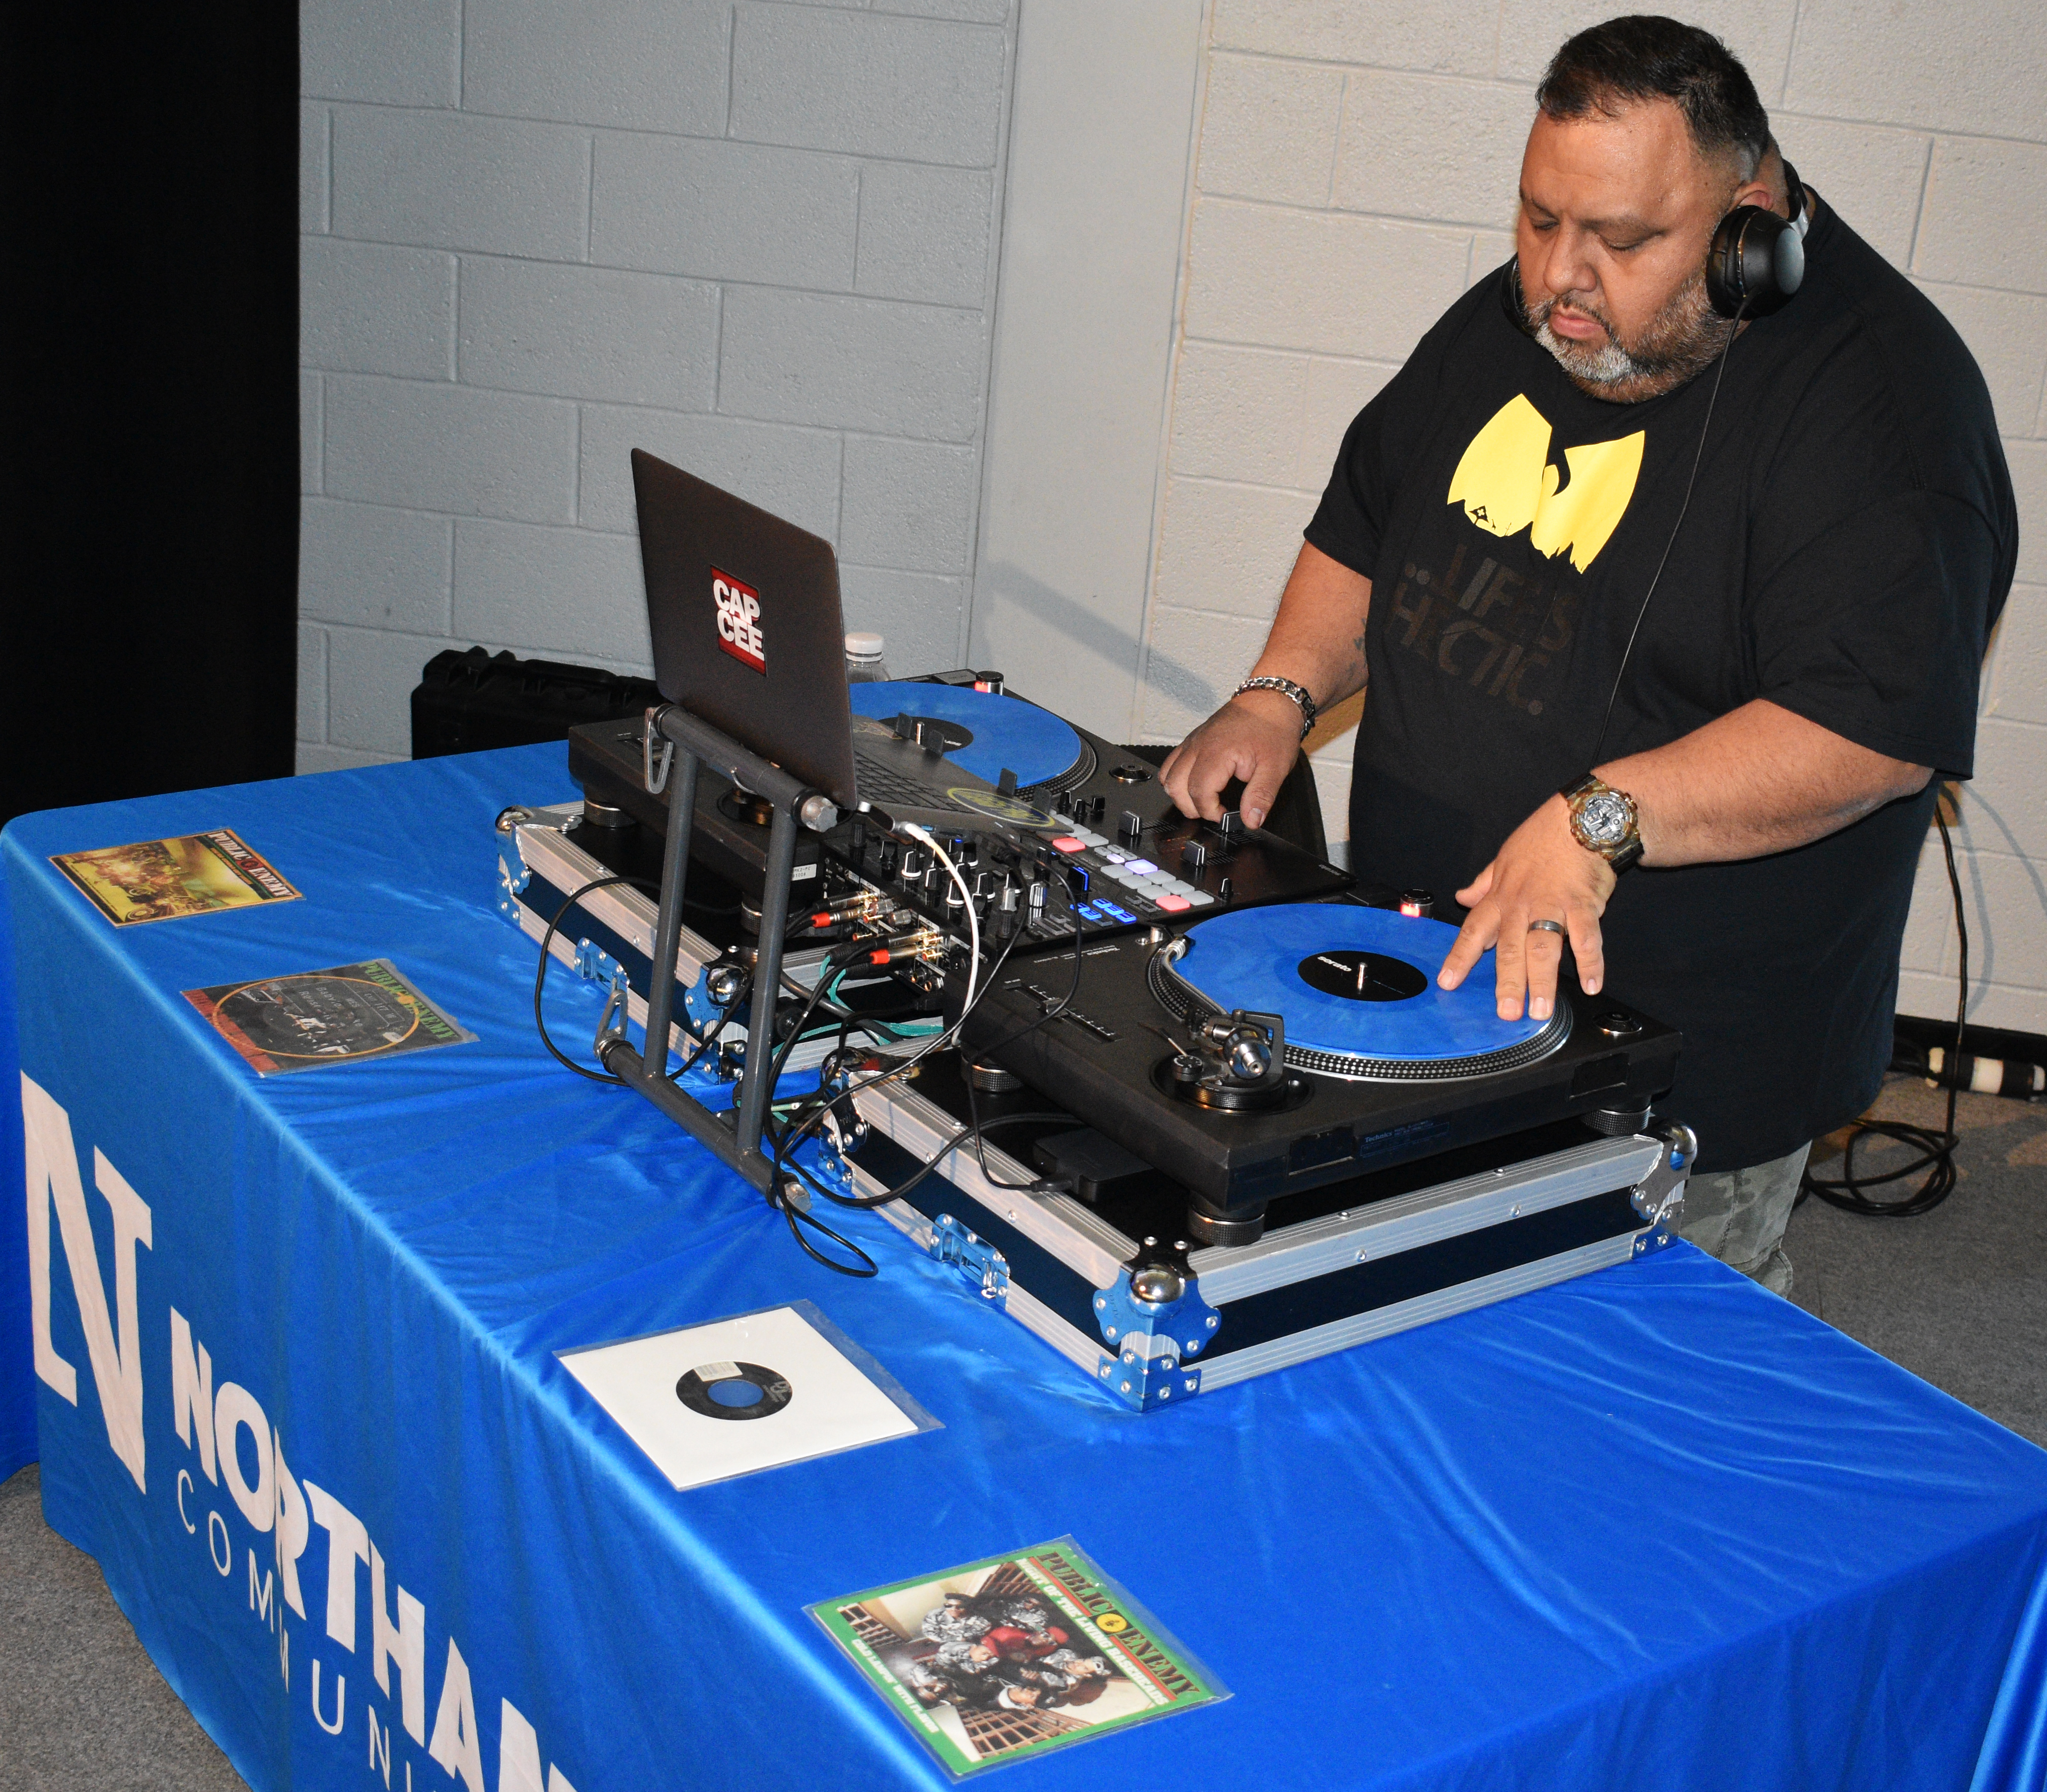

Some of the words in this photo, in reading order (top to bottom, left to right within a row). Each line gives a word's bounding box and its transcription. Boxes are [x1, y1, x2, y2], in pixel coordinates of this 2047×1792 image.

[713, 579, 760, 625] CAP
[717, 609, 765, 661] CEE
[208, 831, 253, 860] PUBLIC
[248, 867, 293, 896] ENEMY
[1317, 956, 1352, 972] serato
[20, 1070, 153, 1494] N
[1015, 1558, 1051, 1585] NIGHT
[1043, 1585, 1064, 1597] OF
[1057, 1596, 1083, 1618] THE
[1077, 1617, 1114, 1649] LIVING
[1105, 1647, 1170, 1705] BASEHEADS
[1037, 1551, 1113, 1613] PUBLIC
[1115, 1628, 1200, 1696] ENEMY
